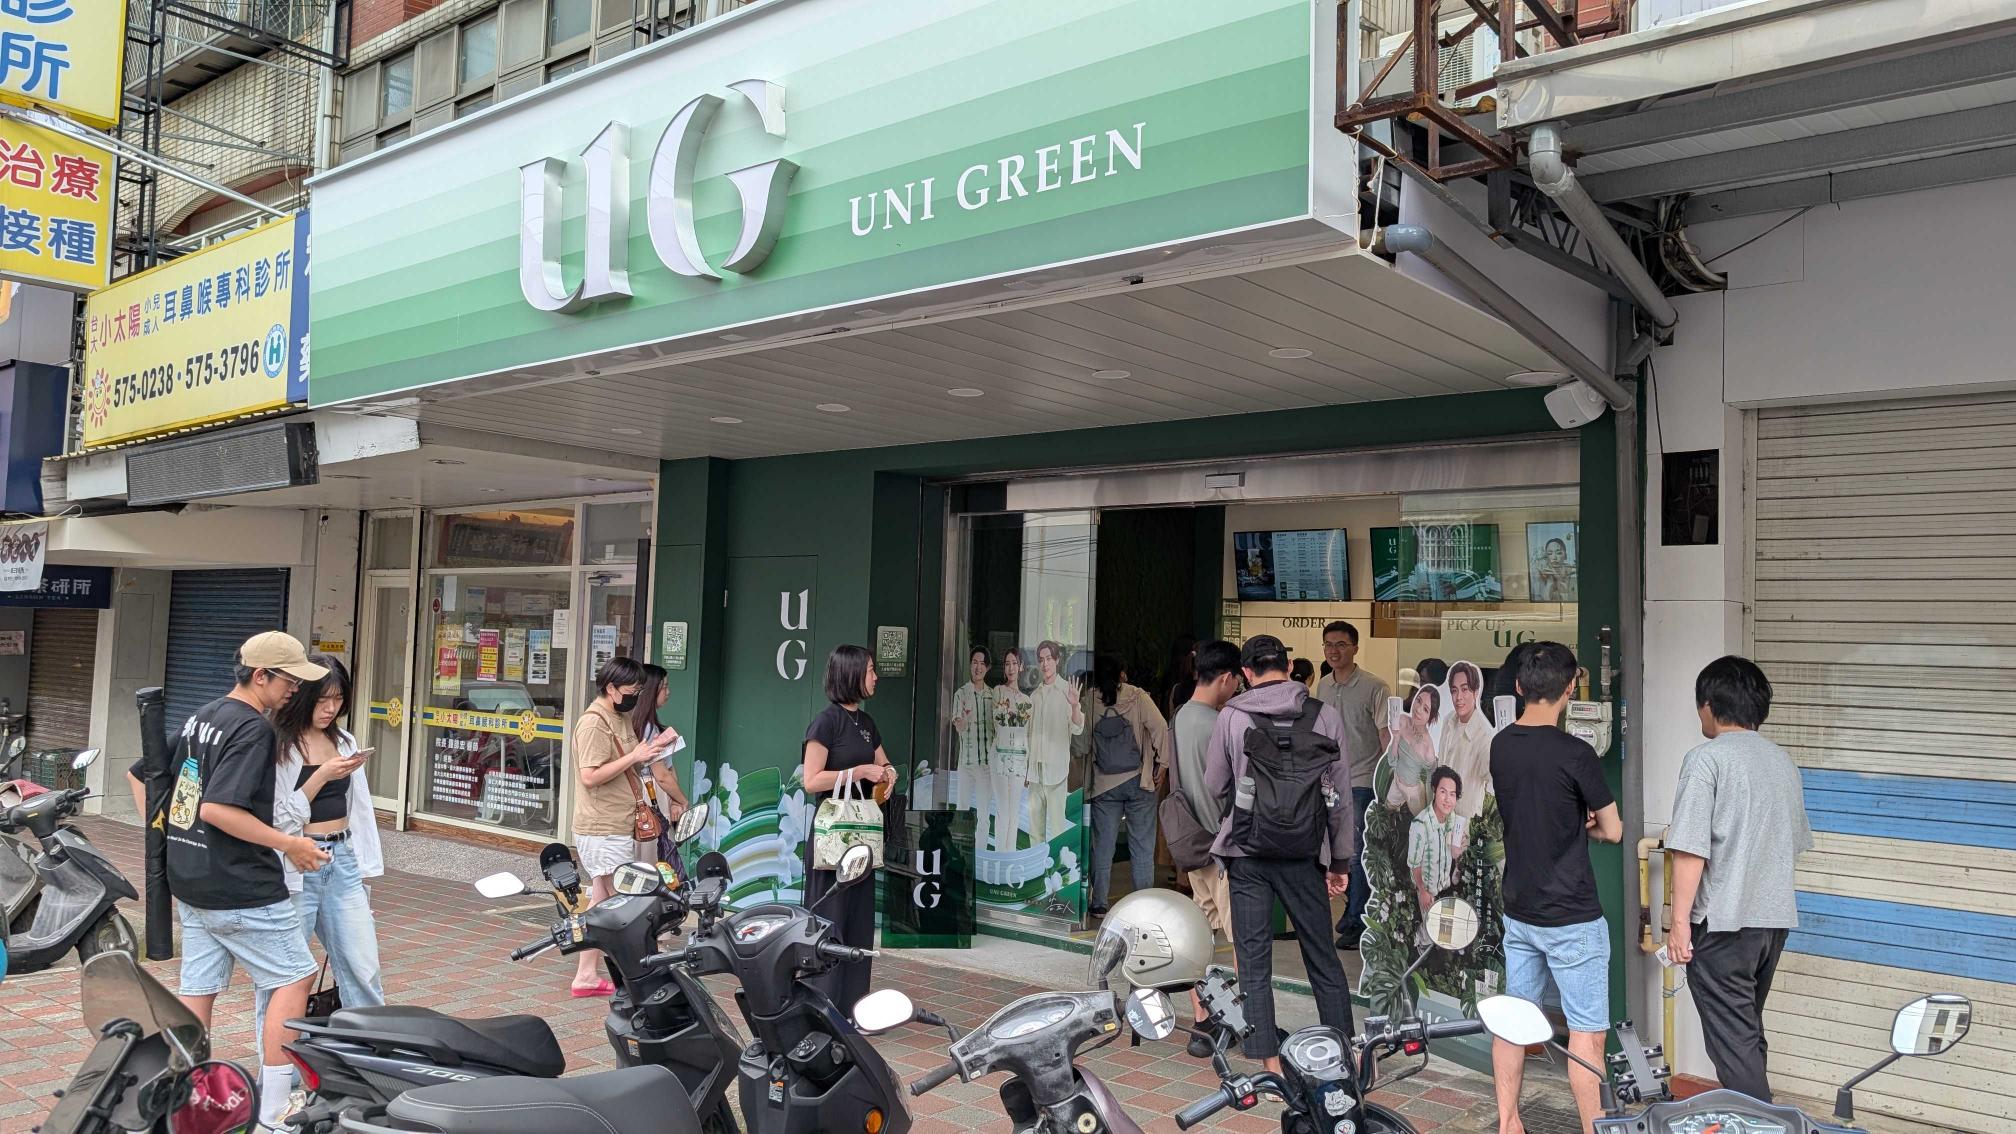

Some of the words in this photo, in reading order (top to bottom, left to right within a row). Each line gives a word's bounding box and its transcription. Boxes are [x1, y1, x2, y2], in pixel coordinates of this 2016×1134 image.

[0, 139, 100, 201] 治療
[849, 177, 935, 236] UNI
[956, 122, 1146, 210] GREEN
[0, 205, 96, 264] 接種
[100, 303, 141, 348] 小太陽
[114, 363, 174, 408] 575-0238
[185, 339, 259, 390] 575-3796
[1282, 617, 1326, 629] ORDER
[401, 1067, 478, 1082] JOG
